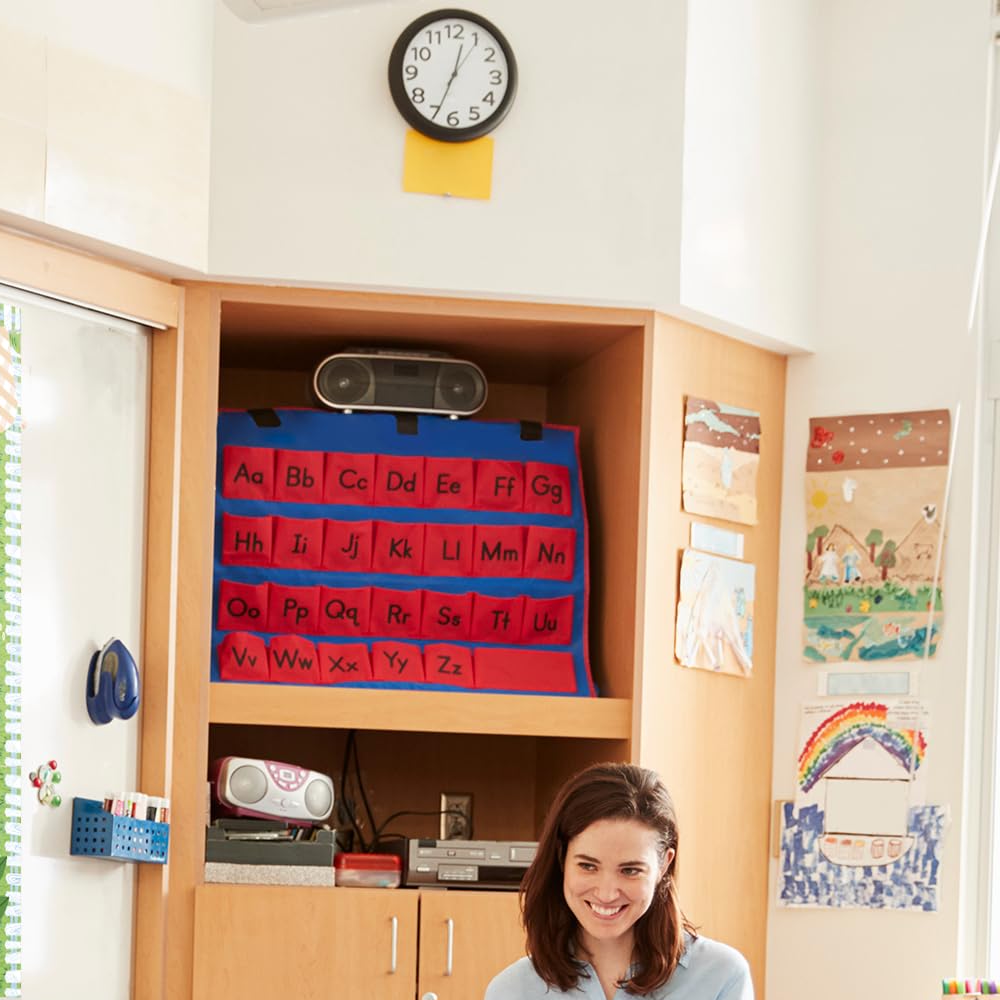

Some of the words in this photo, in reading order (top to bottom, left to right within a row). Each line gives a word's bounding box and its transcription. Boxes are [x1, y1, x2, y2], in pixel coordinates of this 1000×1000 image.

[425, 30, 441, 45] 11
[444, 24, 465, 40] 12
[472, 32, 478, 46] 1
[411, 46, 431, 62] 10
[484, 47, 496, 63] 2
[405, 65, 418, 80] 9
[489, 70, 502, 85] 3
[411, 87, 425, 104] 8
[481, 91, 496, 106] 4
[429, 104, 441, 120] 7
[446, 111, 460, 127] 6
[468, 106, 480, 121] 5
[233, 463, 263, 485] Aa
[286, 467, 314, 488] Bb
[338, 470, 368, 491] Cc
[387, 472, 416, 492] Dd
[437, 474, 461, 494] Ee
[495, 477, 516, 496] Ff
[531, 475, 562, 504] Gg
[235, 532, 263, 552] Hh
[293, 534, 308, 554] Ii
[342, 534, 359, 559] Jj
[390, 538, 412, 558] Kk
[443, 541, 460, 561] Ll
[481, 542, 518, 562] Mm
[538, 543, 565, 564] Nn
[227, 598, 260, 619] Oo
[283, 599, 308, 624] Pp
[325, 600, 360, 626] Qq
[388, 605, 411, 624] Rr
[438, 607, 460, 627] Ss
[491, 611, 510, 630] Tt
[533, 612, 557, 631] Uu
[232, 647, 257, 667] Vv
[273, 649, 312, 670] Ww
[329, 656, 359, 672] Xx
[383, 652, 408, 673] Yy
[438, 656, 462, 675] Zz
